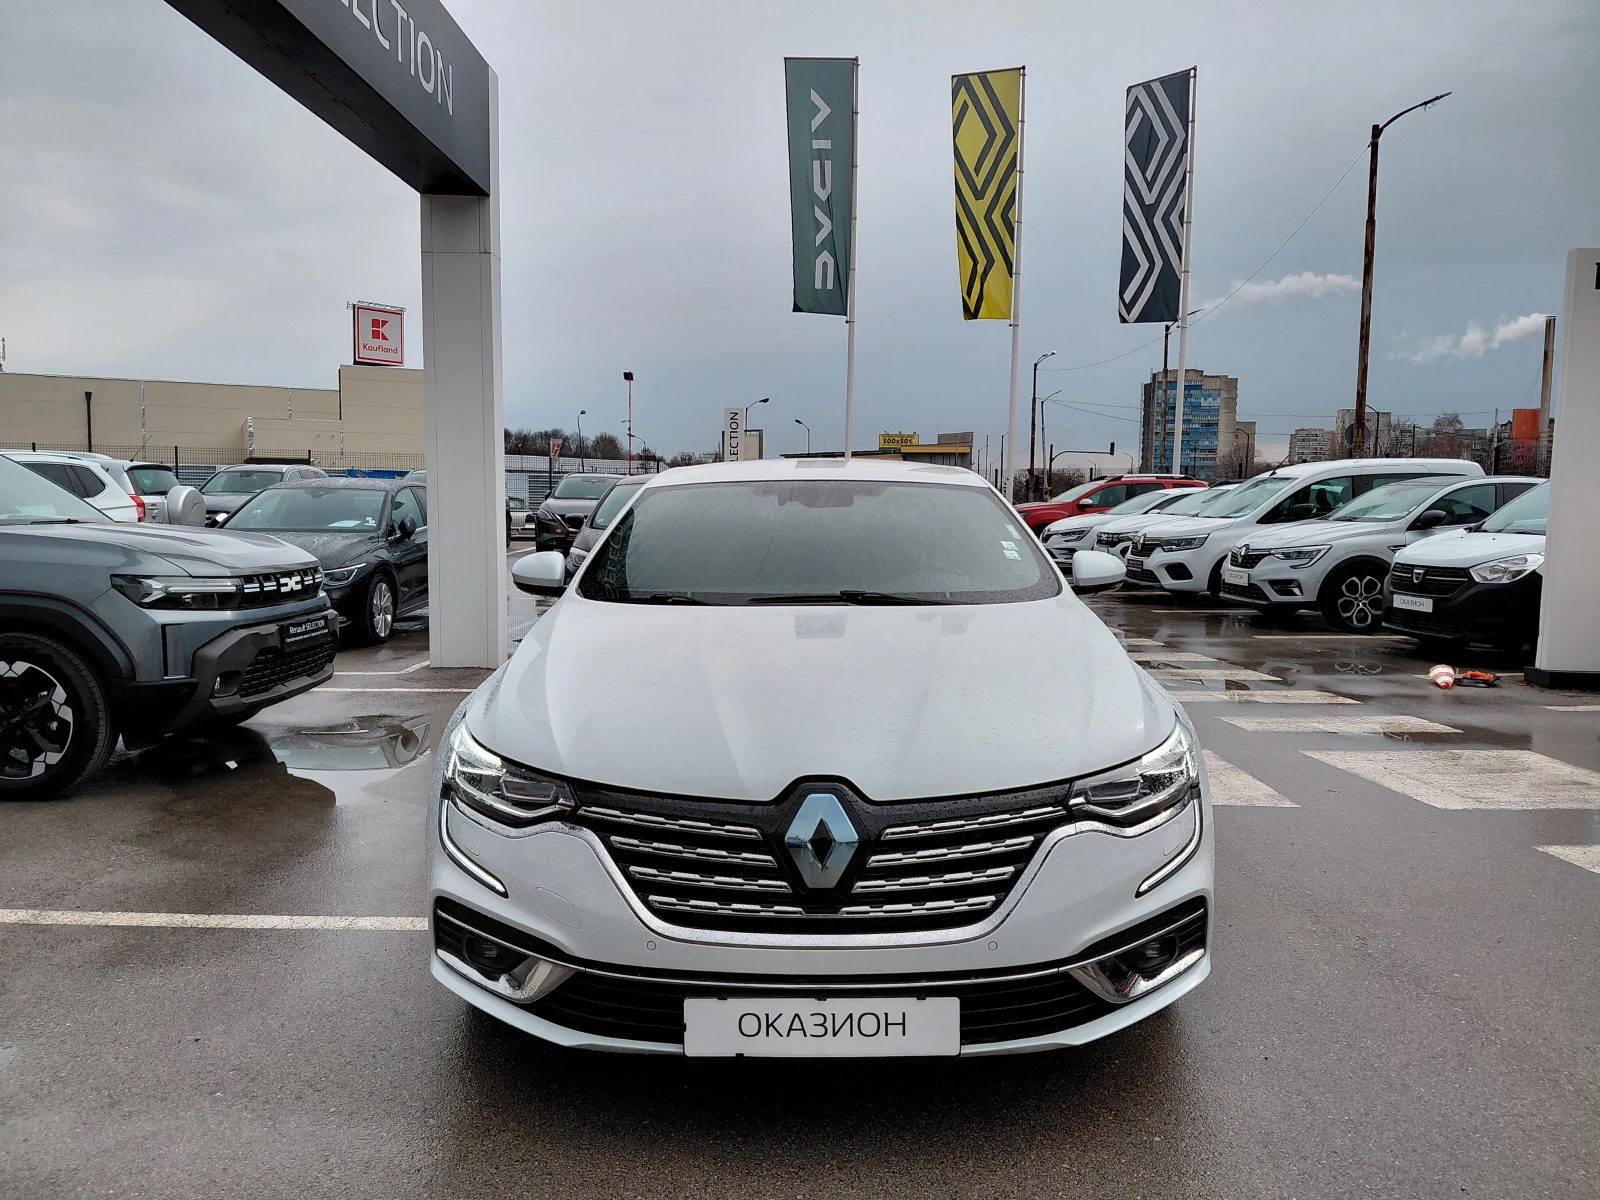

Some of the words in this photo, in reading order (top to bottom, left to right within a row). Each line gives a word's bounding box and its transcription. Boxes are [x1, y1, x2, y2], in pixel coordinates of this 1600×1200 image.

[362, 343, 398, 354] Kaufland
[289, 623, 306, 635] Renault
[738, 1012, 906, 1037] ОКАЗИОН
